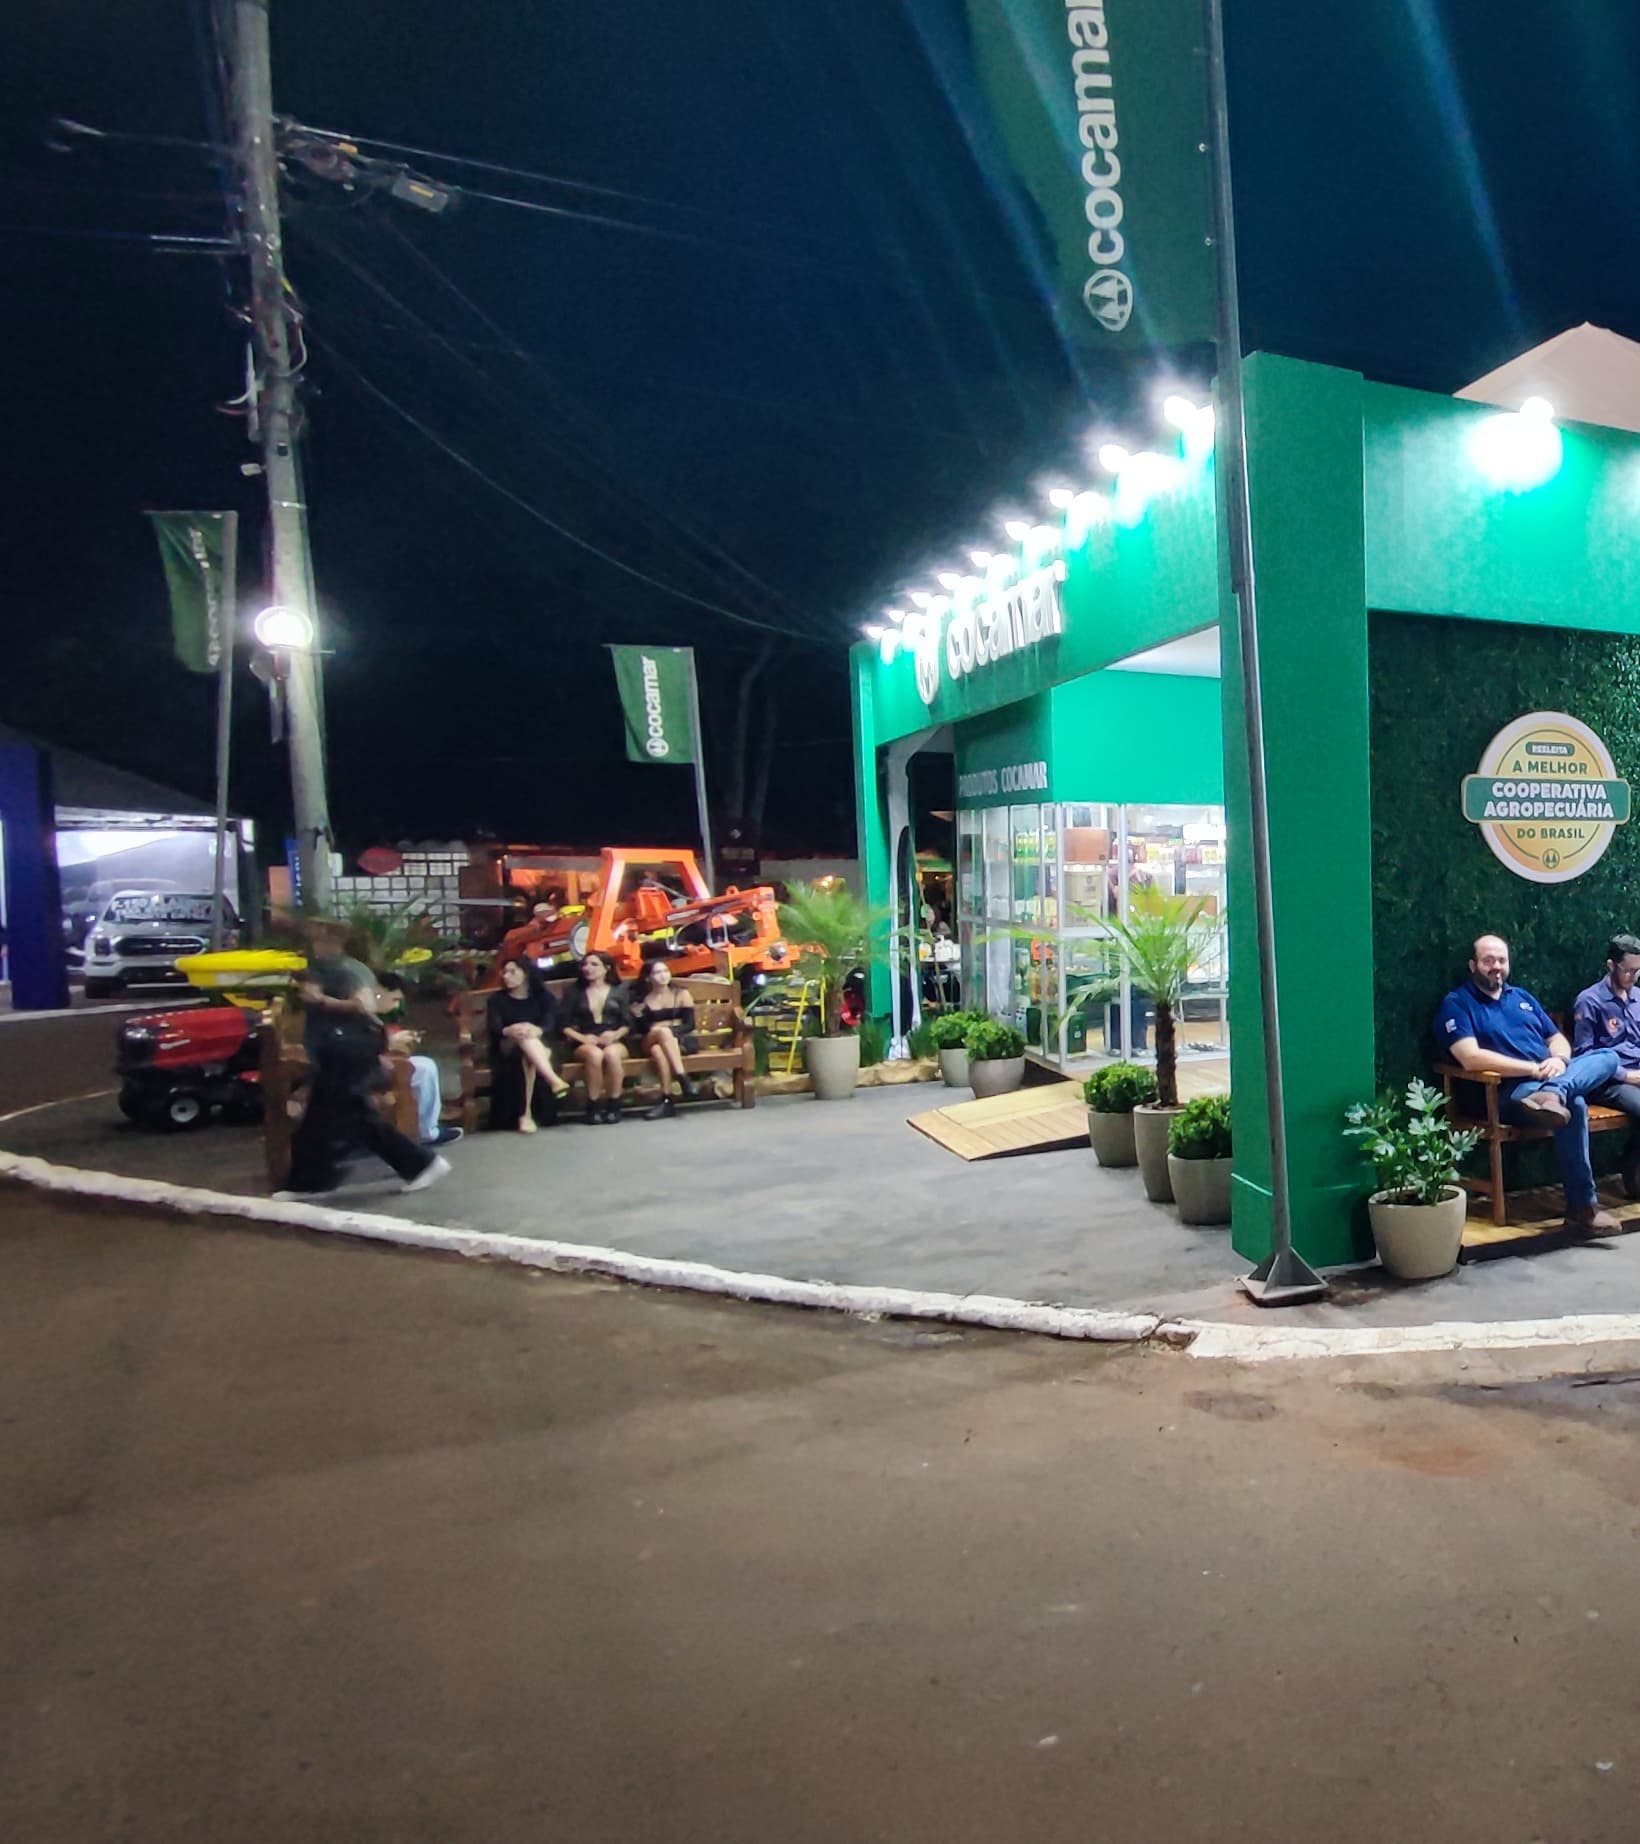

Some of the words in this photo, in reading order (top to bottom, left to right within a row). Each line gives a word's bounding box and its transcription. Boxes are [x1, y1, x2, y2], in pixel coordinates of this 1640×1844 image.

[946, 560, 1067, 680] cocamar
[641, 655, 664, 738] cocamar
[1001, 761, 1048, 792] COCAMAR
[1512, 760, 1523, 773] A
[1527, 761, 1588, 775] MELHOR
[1491, 782, 1607, 800] COOPERATIVA
[1483, 798, 1615, 818] AGROPECUÁRIA
[1517, 828, 1536, 839] DO
[1540, 828, 1585, 839] BRASIL
